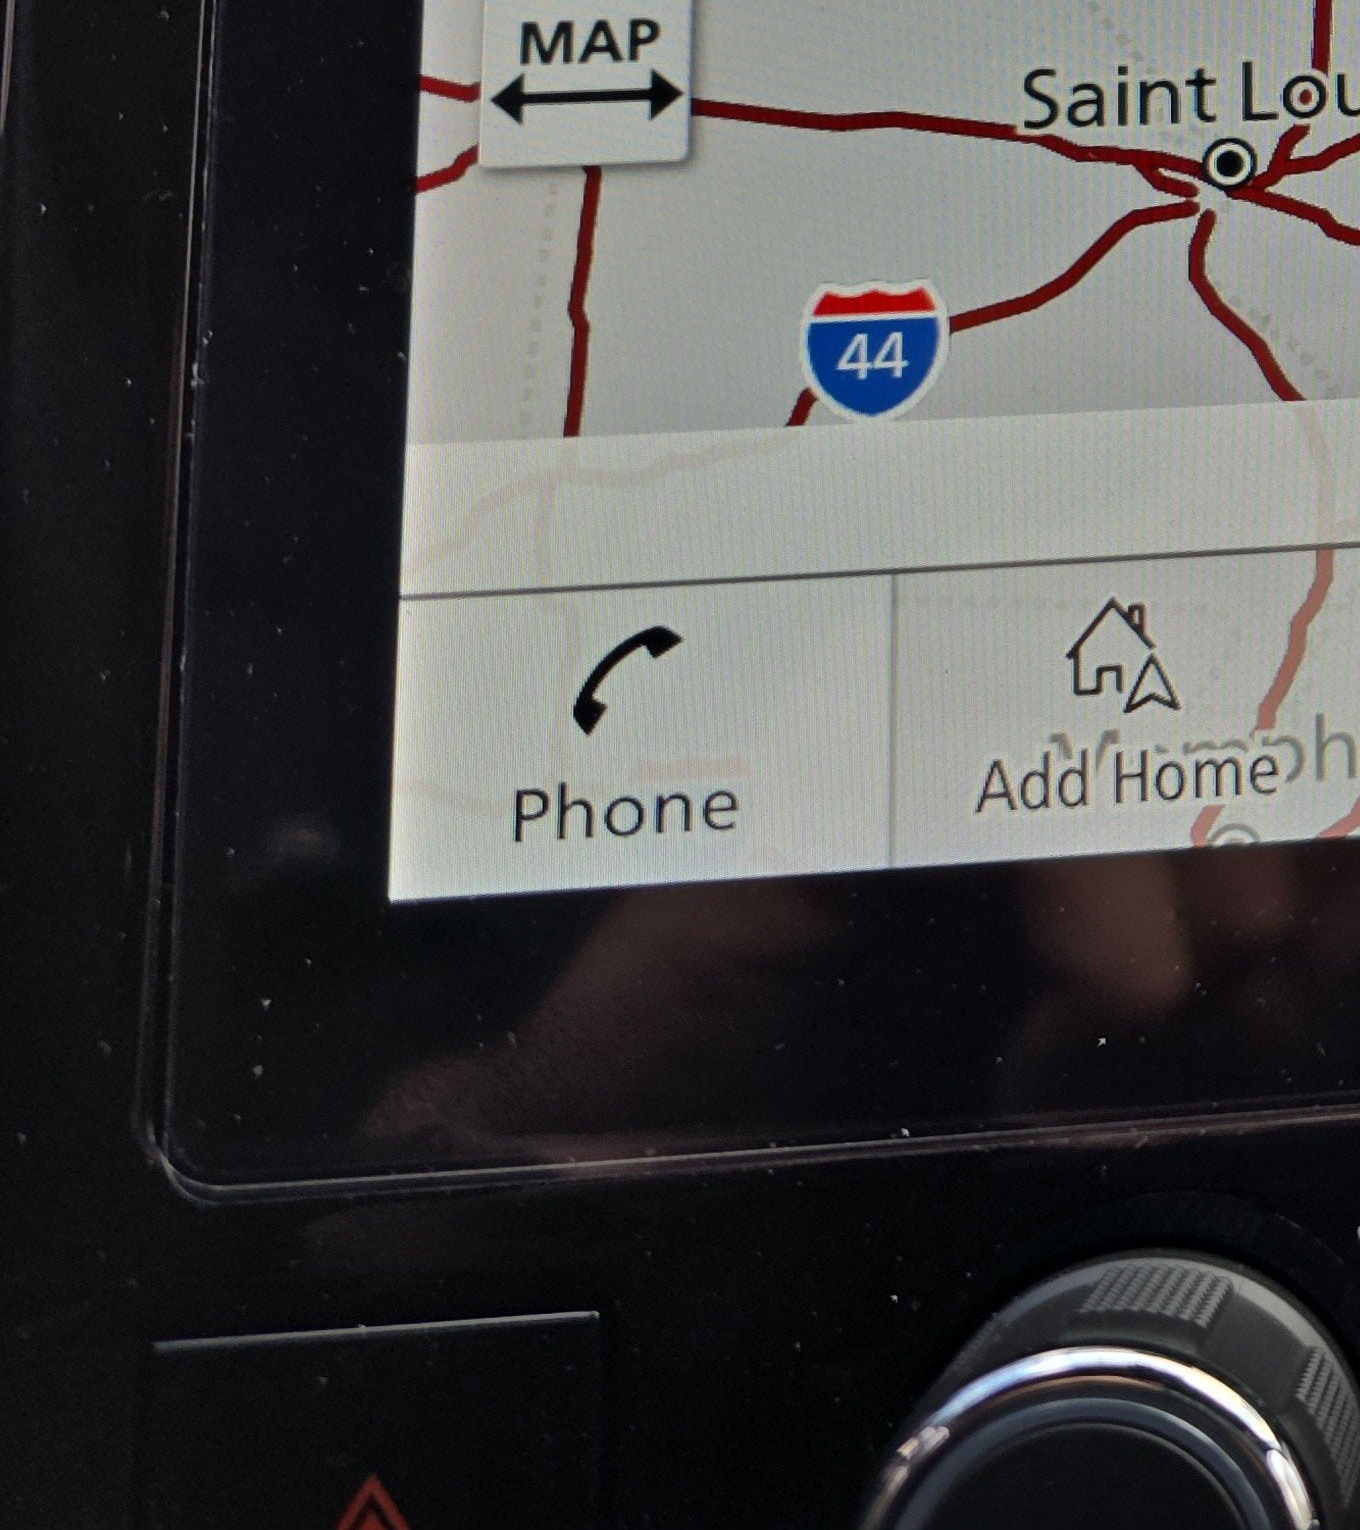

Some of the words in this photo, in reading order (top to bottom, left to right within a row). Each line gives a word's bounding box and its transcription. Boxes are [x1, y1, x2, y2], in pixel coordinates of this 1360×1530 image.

[519, 18, 661, 65] MAP
[1023, 68, 1216, 130] Saint
[835, 330, 909, 380] 44
[975, 747, 1090, 812] Add
[1114, 748, 1280, 804] Home
[513, 782, 740, 842] Phone
